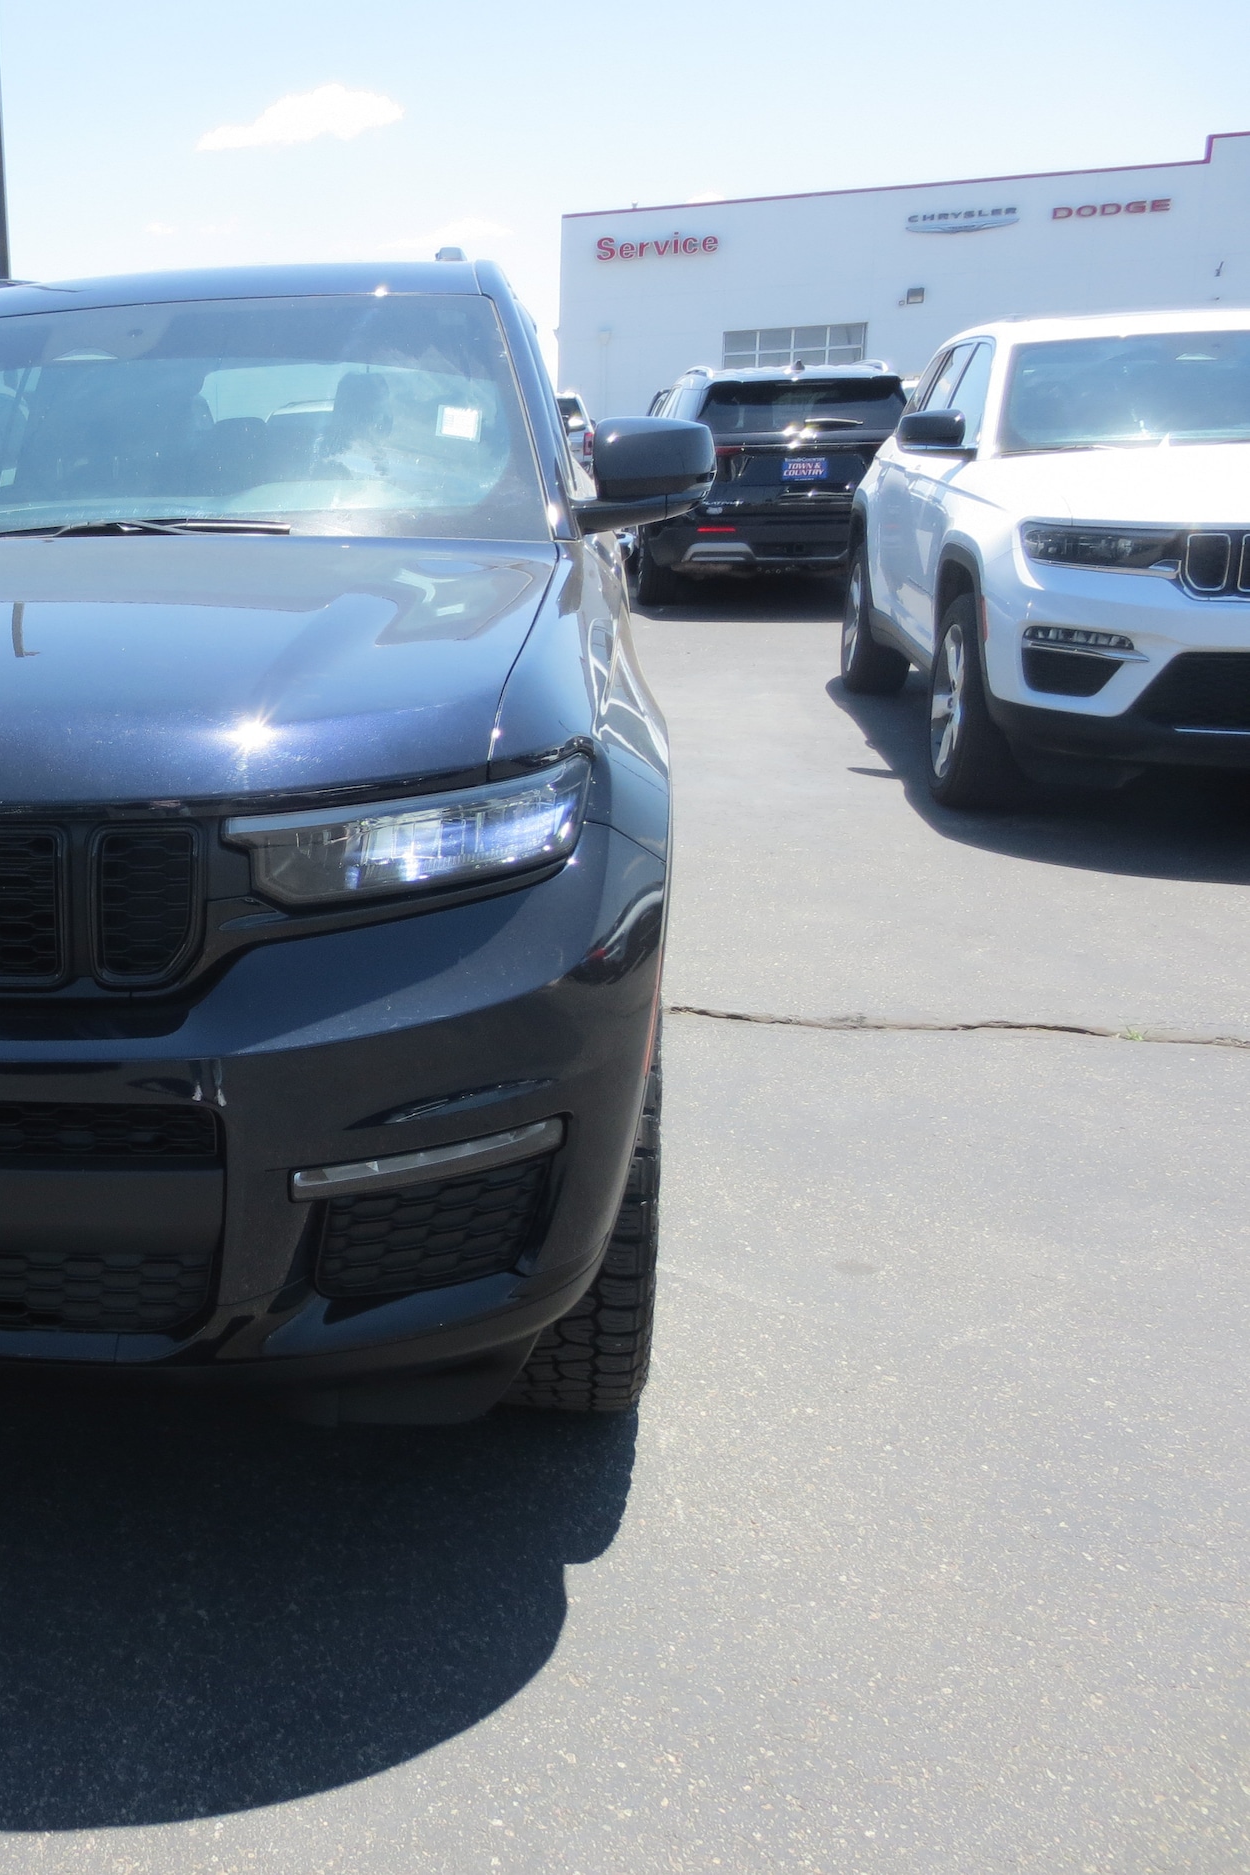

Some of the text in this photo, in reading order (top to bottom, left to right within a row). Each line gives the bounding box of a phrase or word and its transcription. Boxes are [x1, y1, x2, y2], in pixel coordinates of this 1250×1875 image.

[907, 207, 1018, 223] CHRYSLER
[1052, 198, 1171, 220] DODGE
[595, 231, 720, 261] Service
